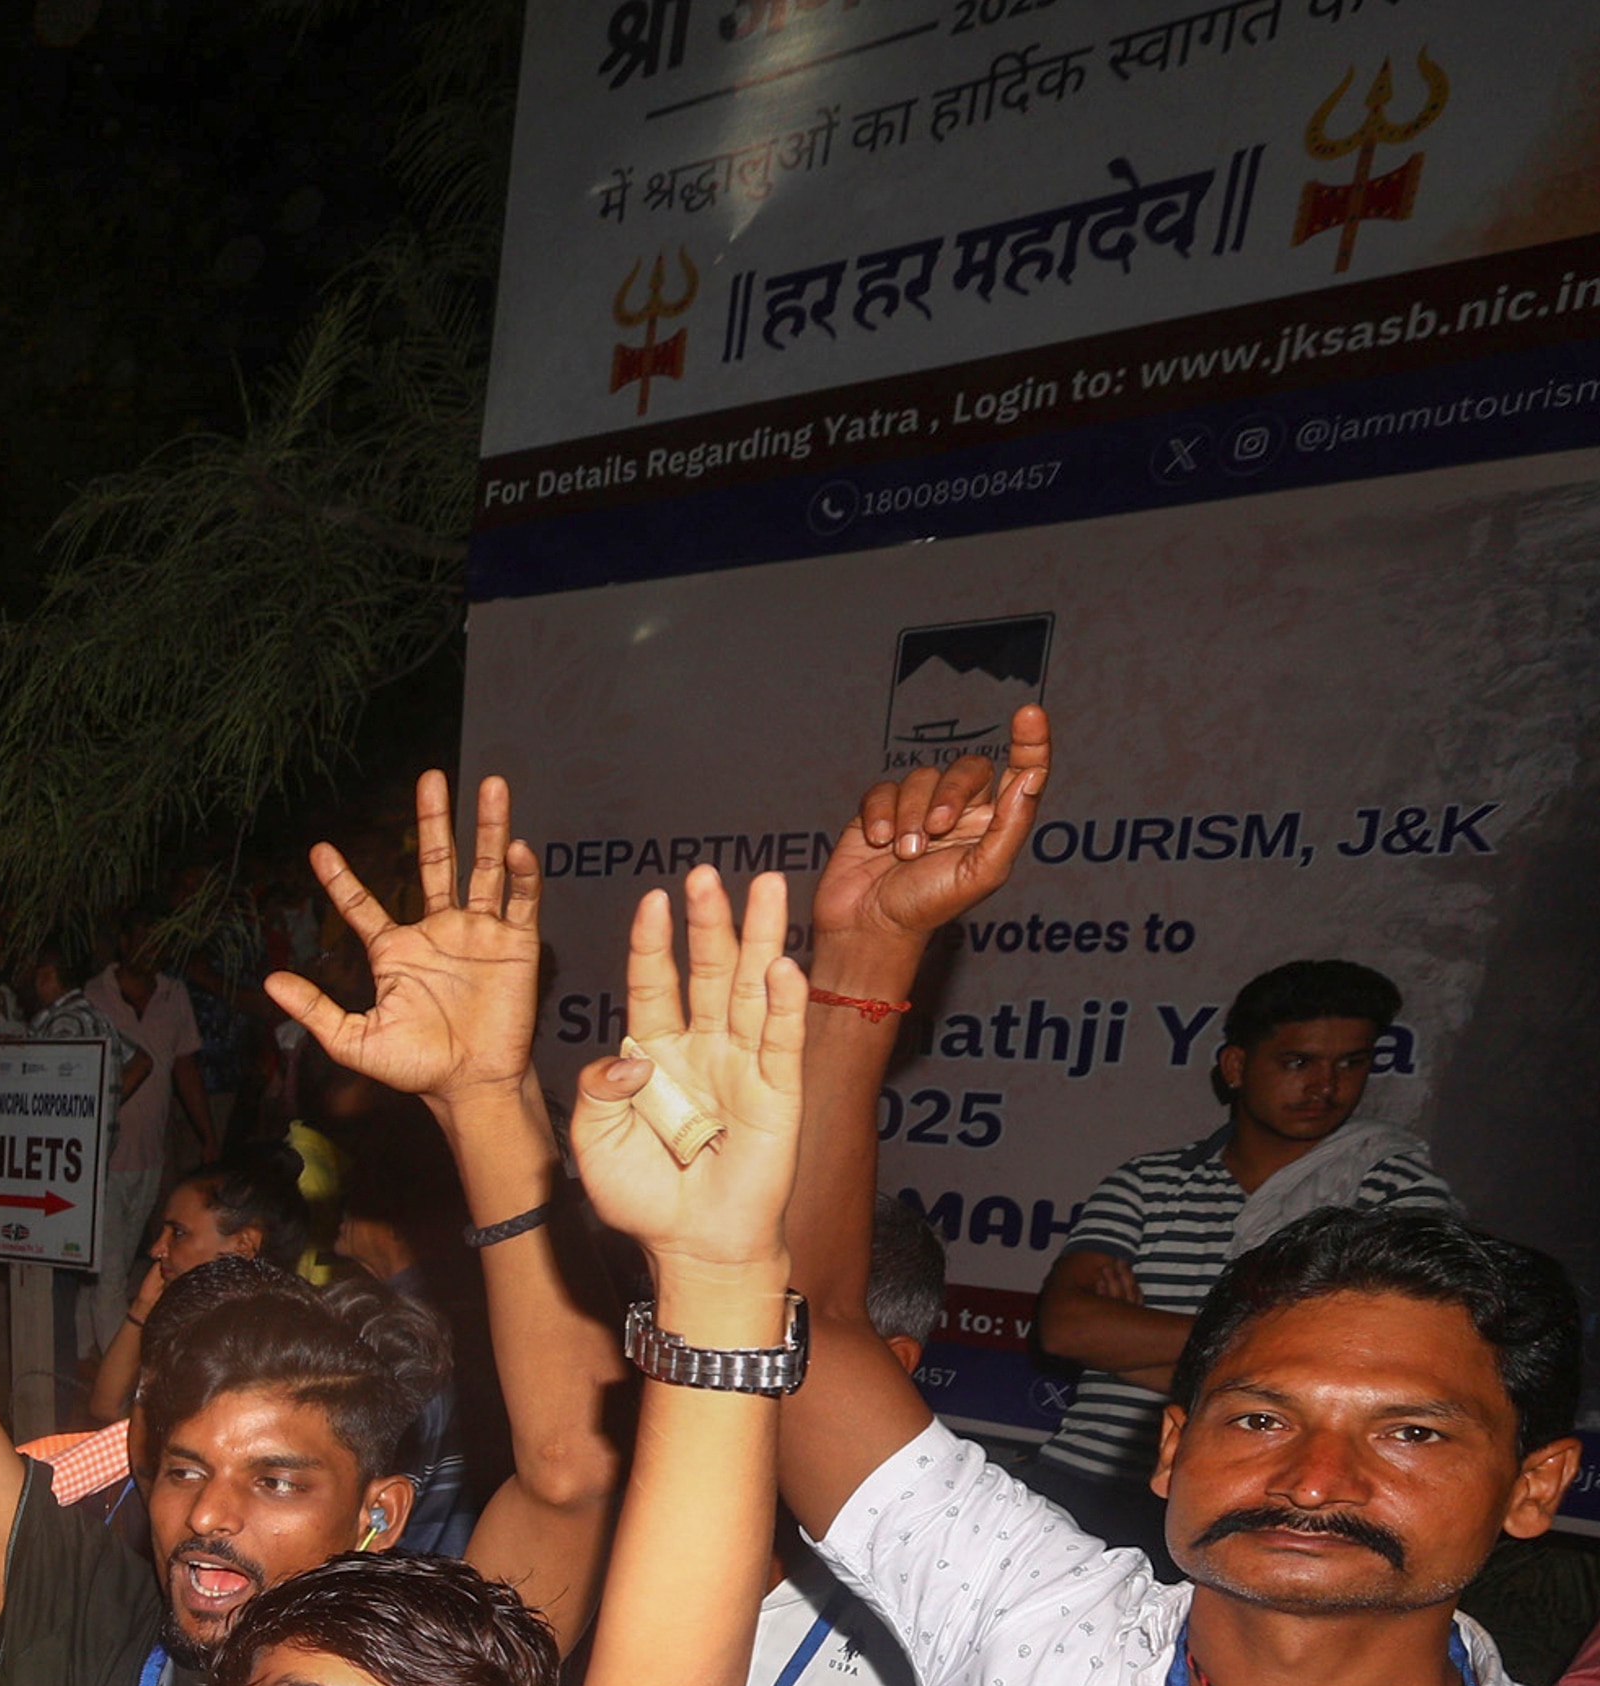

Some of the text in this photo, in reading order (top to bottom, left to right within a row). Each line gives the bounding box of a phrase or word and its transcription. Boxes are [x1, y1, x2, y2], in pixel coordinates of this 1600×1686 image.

[853, 98, 919, 153] का
[931, 43, 1094, 142] हार्दिक
[853, 237, 944, 331] हर
[483, 477, 530, 509] For
[536, 457, 638, 497] Details
[646, 425, 814, 480] Regarding
[823, 405, 919, 446] Yatra
[952, 374, 1058, 426] Login
[1071, 365, 1127, 403] to:
[1140, 270, 1600, 390] www.jksasb.nic.in
[862, 461, 1063, 518] 18008908457
[882, 750, 922, 772] J&K
[545, 803, 1499, 878] DEPARTMEN OURISM, J&K
[938, 914, 1195, 953] evotees to
[557, 993, 627, 1044] Sh
[31, 1093, 96, 1119] CORPORATION
[877, 1086, 1003, 1147] 025
[898, 1188, 1086, 1250] MAH
